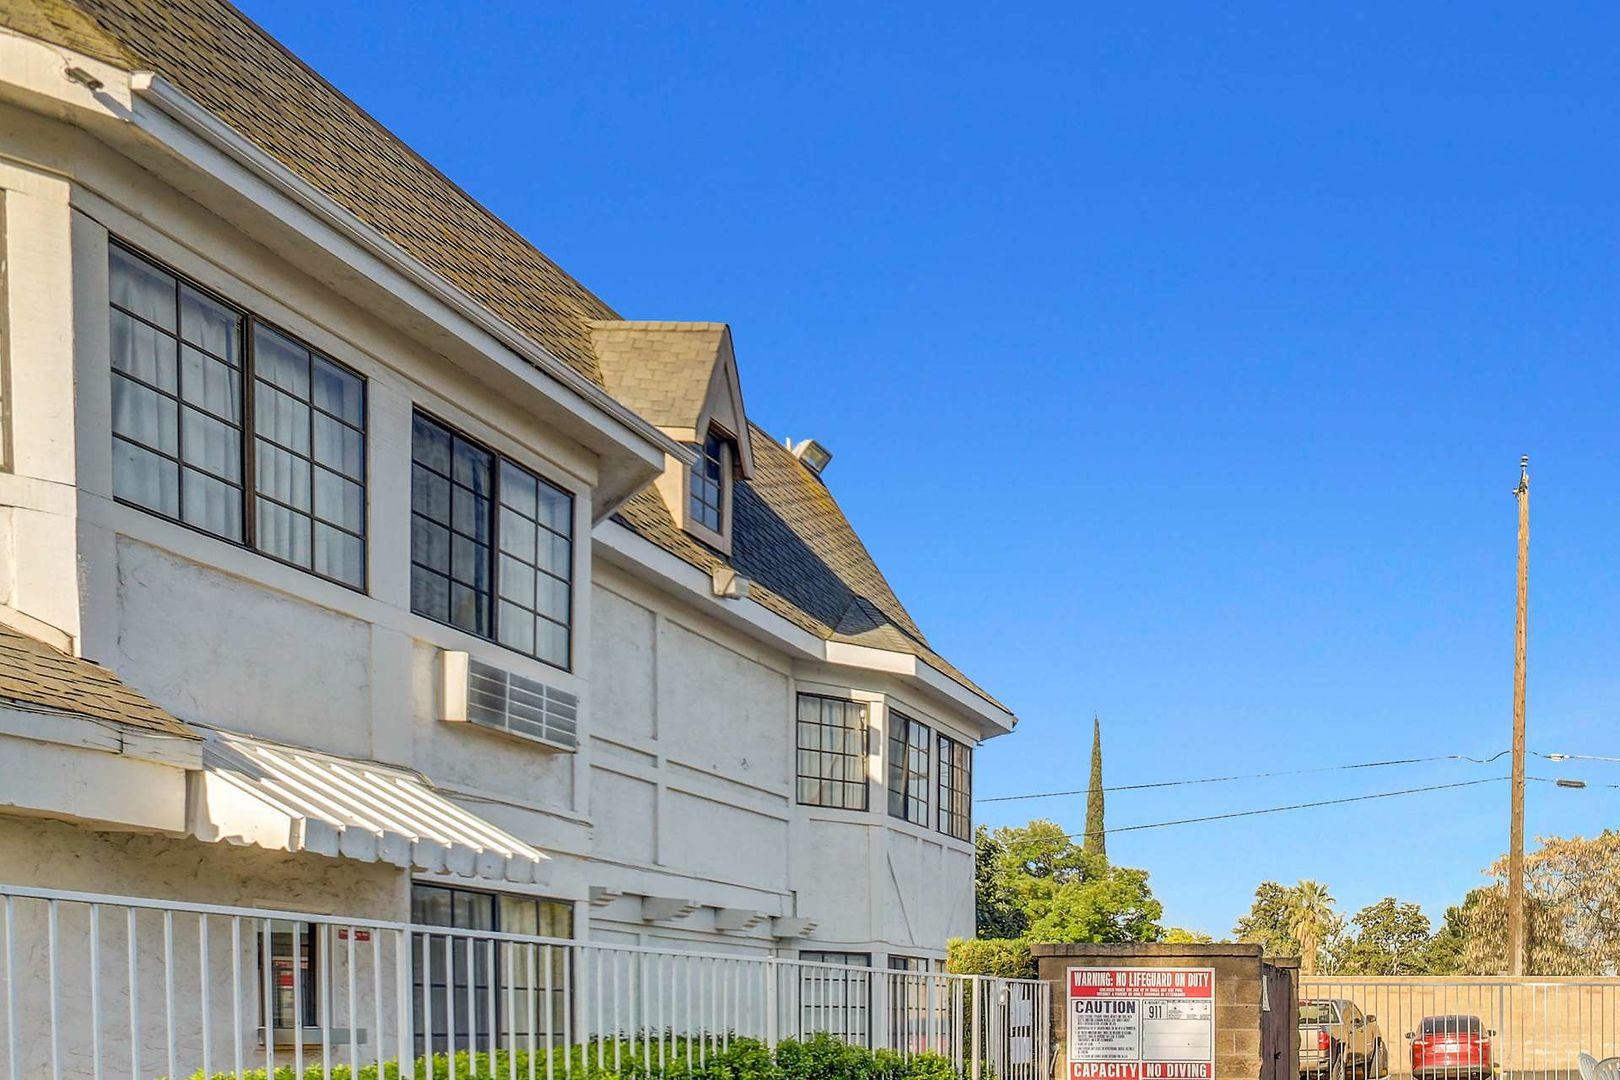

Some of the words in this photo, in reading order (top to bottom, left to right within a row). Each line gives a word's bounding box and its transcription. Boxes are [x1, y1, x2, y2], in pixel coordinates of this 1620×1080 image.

[1074, 972, 1113, 987] WARNING:
[1116, 973, 1126, 987] NO
[1129, 972, 1171, 987] LIFEGUARD
[1175, 973, 1185, 987] ON
[1188, 973, 1209, 987] DUTY
[1075, 1001, 1136, 1014] CAUTION
[1149, 1005, 1162, 1019] 911
[1074, 1063, 1137, 1077] CAPACITY
[1146, 1063, 1162, 1077] NO
[1167, 1063, 1207, 1078] DIVING
